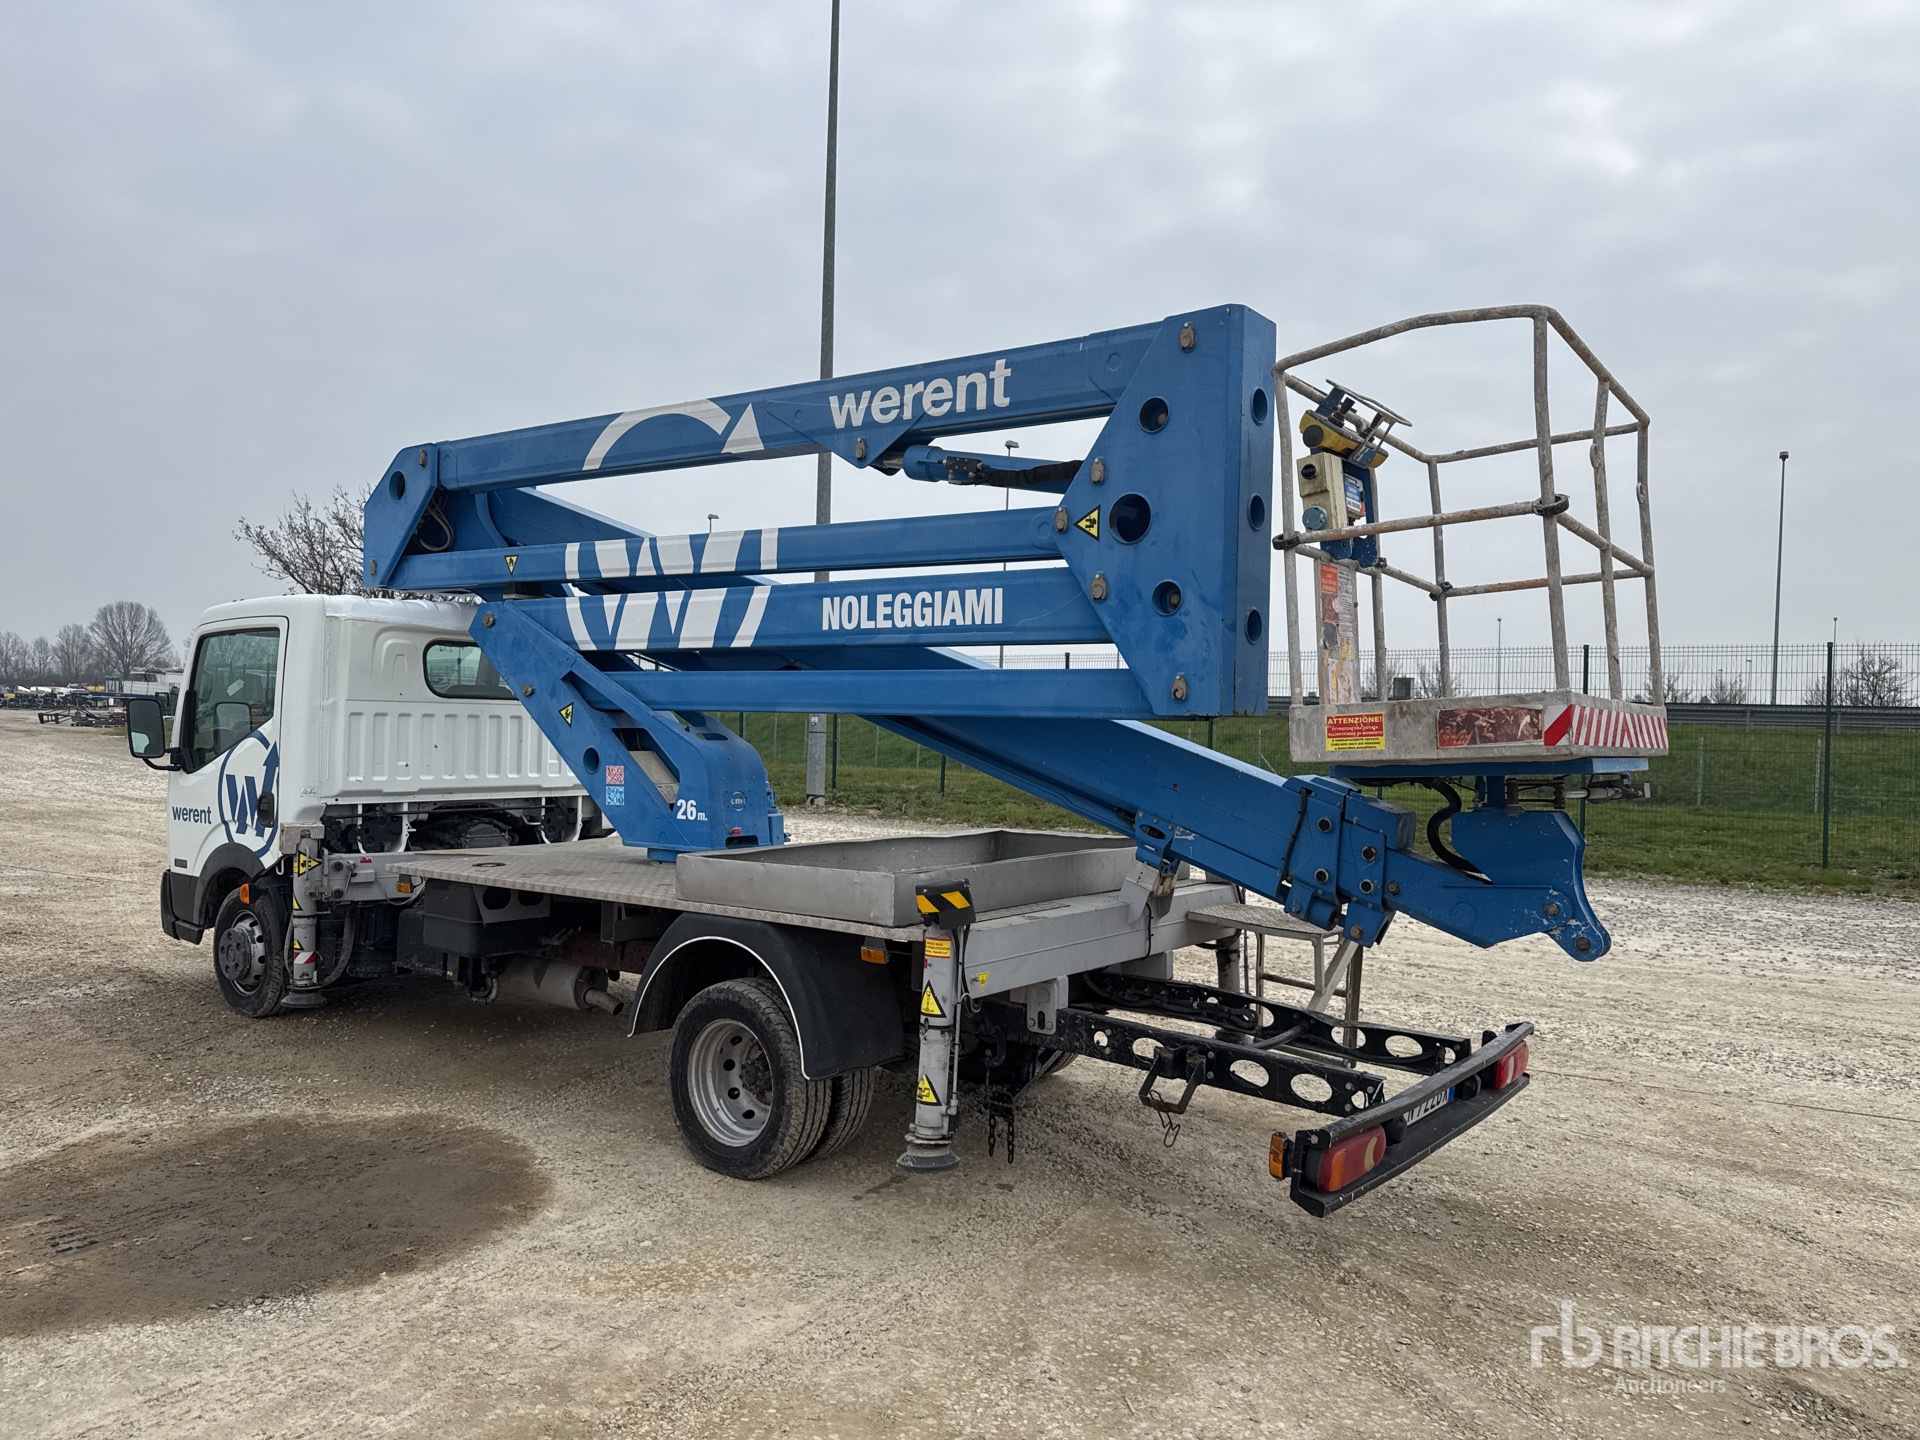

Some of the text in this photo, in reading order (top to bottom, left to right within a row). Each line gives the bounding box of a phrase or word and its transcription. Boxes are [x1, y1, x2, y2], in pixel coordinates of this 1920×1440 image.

[829, 359, 1011, 429] werent
[822, 588, 1003, 631] NOLEGGIAMI
[1328, 716, 1382, 725] ATTENZIONE!
[172, 806, 212, 824] werent
[677, 799, 697, 820] 26
